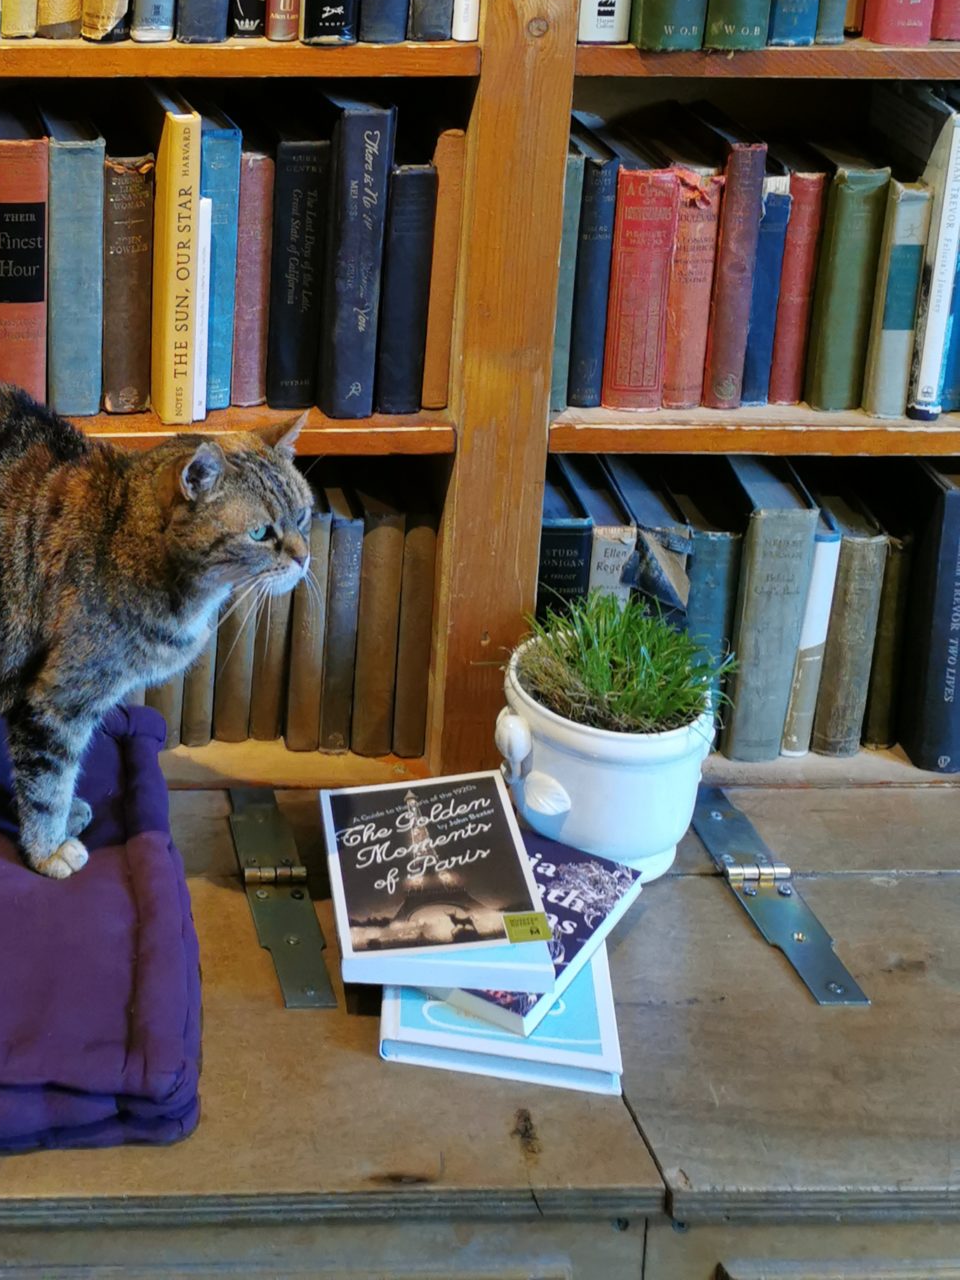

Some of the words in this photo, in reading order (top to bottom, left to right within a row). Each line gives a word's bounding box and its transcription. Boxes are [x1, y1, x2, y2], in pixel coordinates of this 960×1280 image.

[181, 126, 191, 177] HARVARD
[363, 130, 381, 171] There
[362, 187, 379, 209] No
[363, 173, 374, 184] is
[4, 213, 36, 223] THEIR
[178, 185, 193, 233] STAR
[945, 187, 959, 229] TREVOR
[176, 237, 191, 282] OUR
[174, 287, 190, 338] SUN,
[352, 303, 371, 332] You
[173, 340, 188, 379] THE
[174, 386, 184, 417] NOYES
[603, 547, 627, 558] Ellen
[946, 636, 959, 666] TWO
[943, 668, 956, 703] LIVES
[336, 822, 393, 847] The
[396, 798, 491, 832] Golden
[356, 822, 492, 869] Moments
[374, 868, 400, 895] of
[406, 848, 491, 880] Paris
